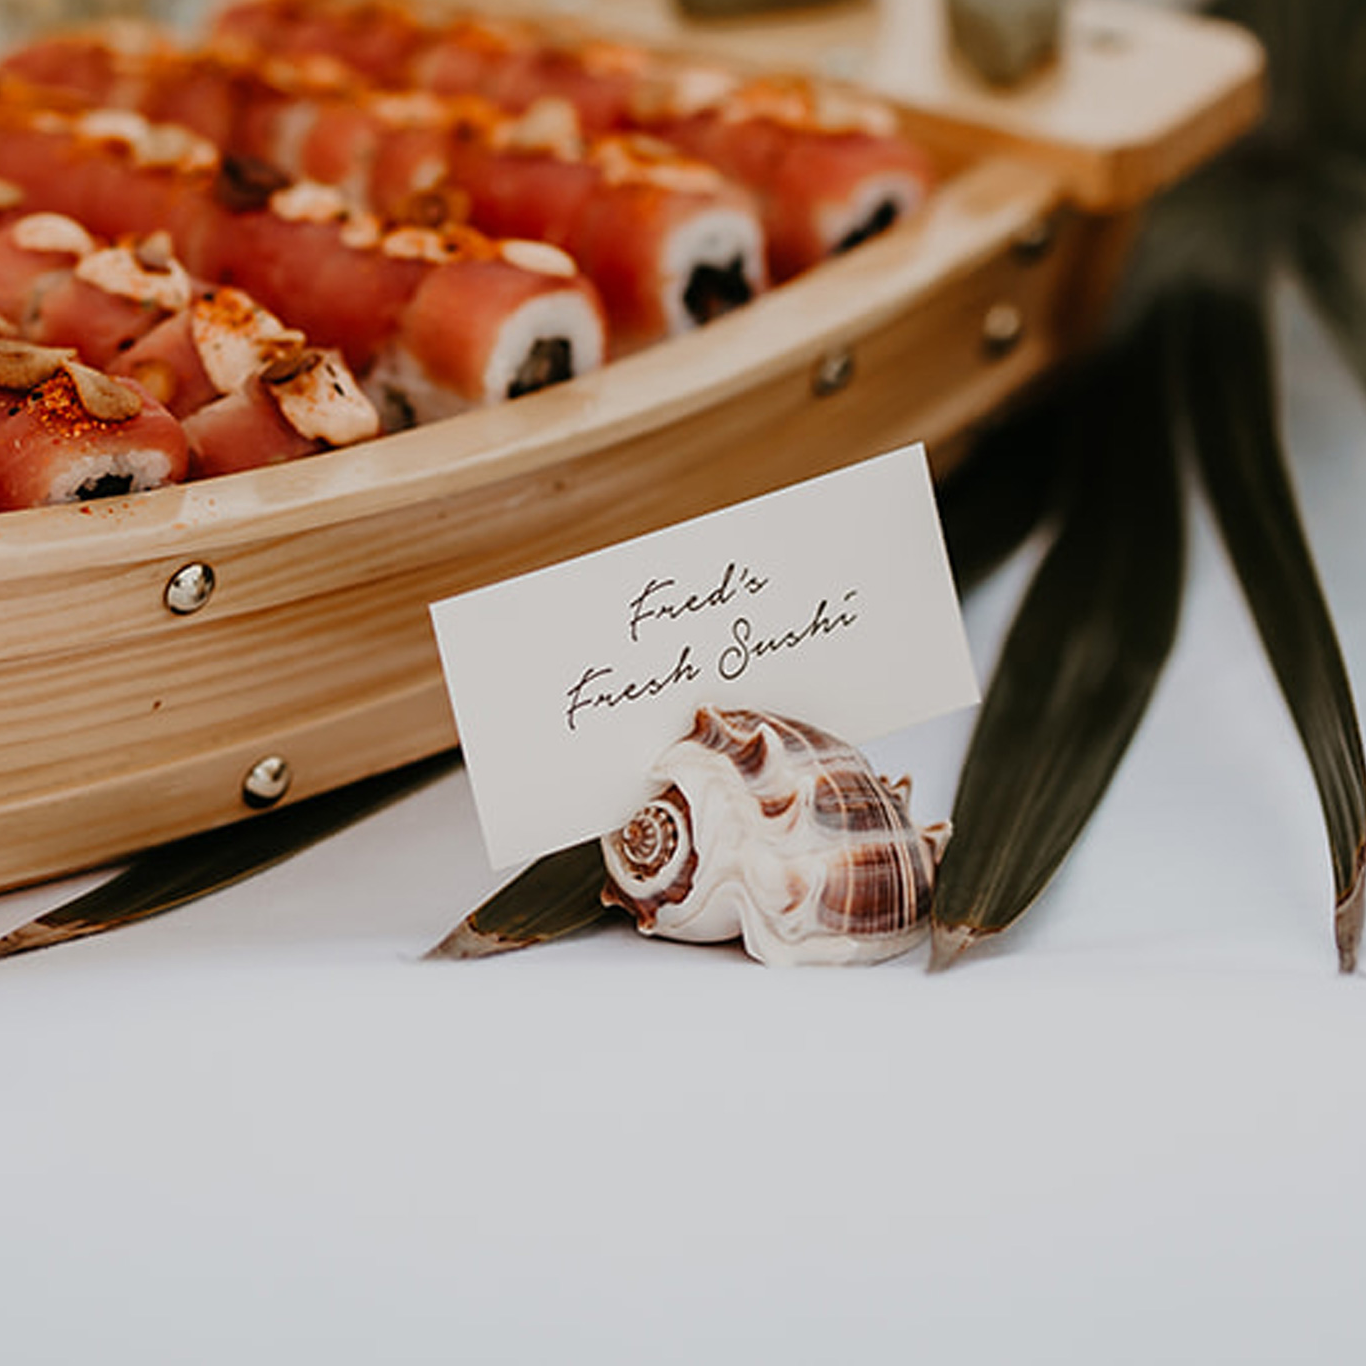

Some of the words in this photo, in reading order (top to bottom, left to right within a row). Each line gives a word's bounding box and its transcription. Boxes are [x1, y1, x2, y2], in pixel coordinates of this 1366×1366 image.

[630, 563, 768, 641] Fred's
[567, 646, 700, 730] Fresh
[718, 590, 857, 680] Sushi
